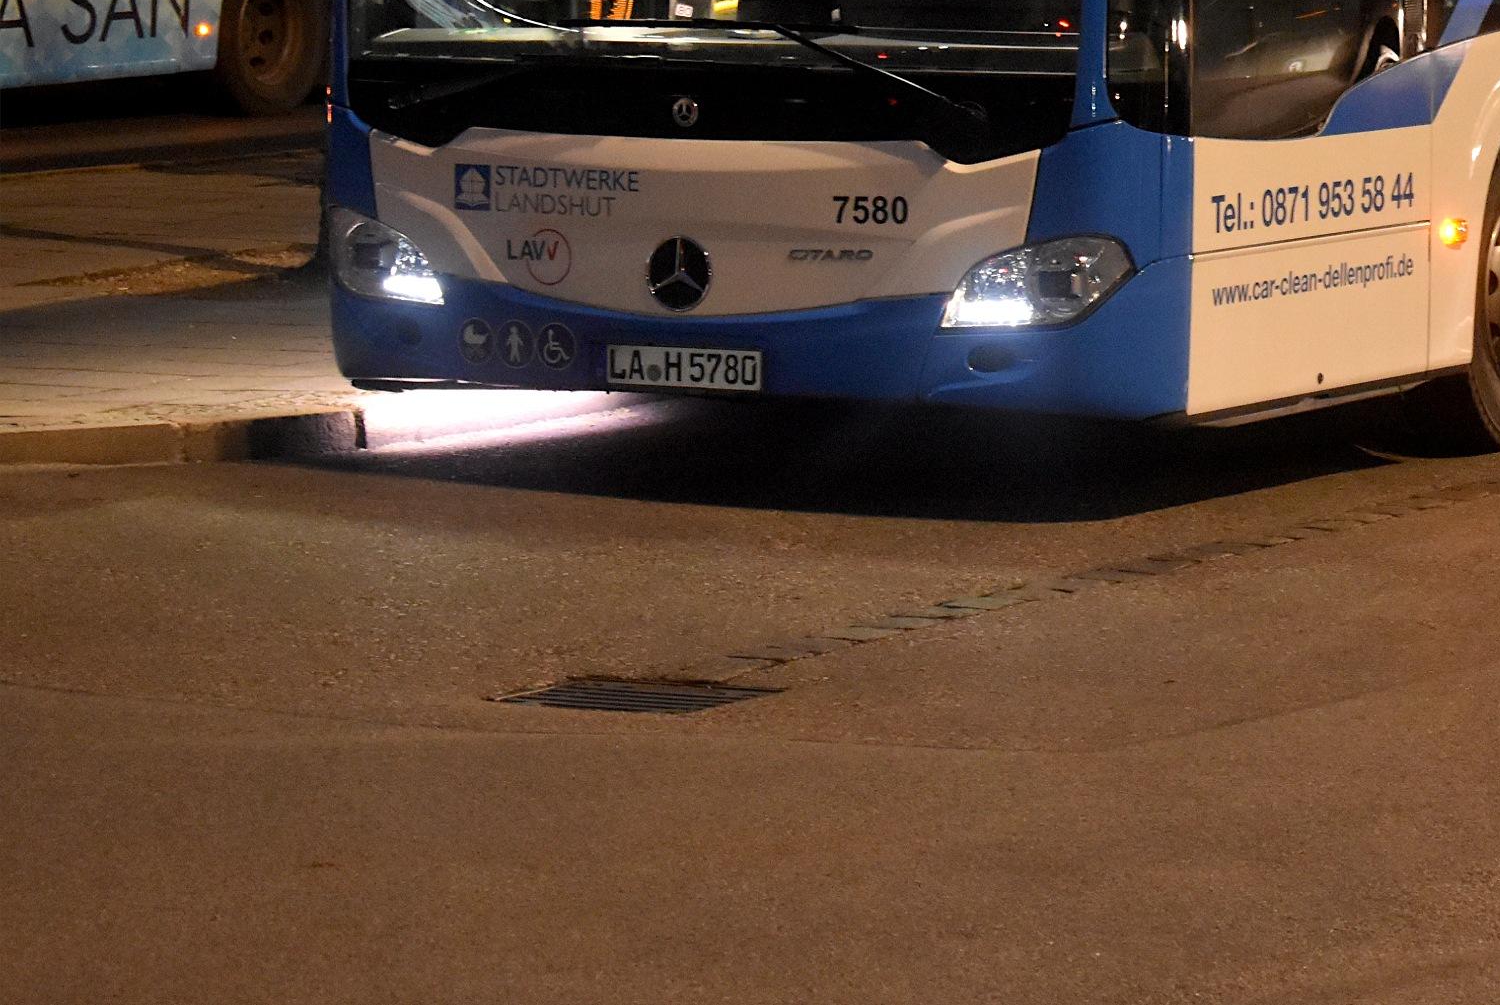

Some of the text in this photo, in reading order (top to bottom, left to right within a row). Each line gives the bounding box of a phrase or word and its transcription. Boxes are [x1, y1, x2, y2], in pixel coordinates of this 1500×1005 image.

[495, 165, 640, 192] STADTWERKE
[495, 194, 617, 217] LANDSHUT
[832, 195, 909, 225] 7580
[1211, 171, 1415, 234] Tel.: 0871 953 58 44
[1212, 252, 1414, 307] www.car-clean-dellenprofi.de
[609, 348, 645, 382] LA
